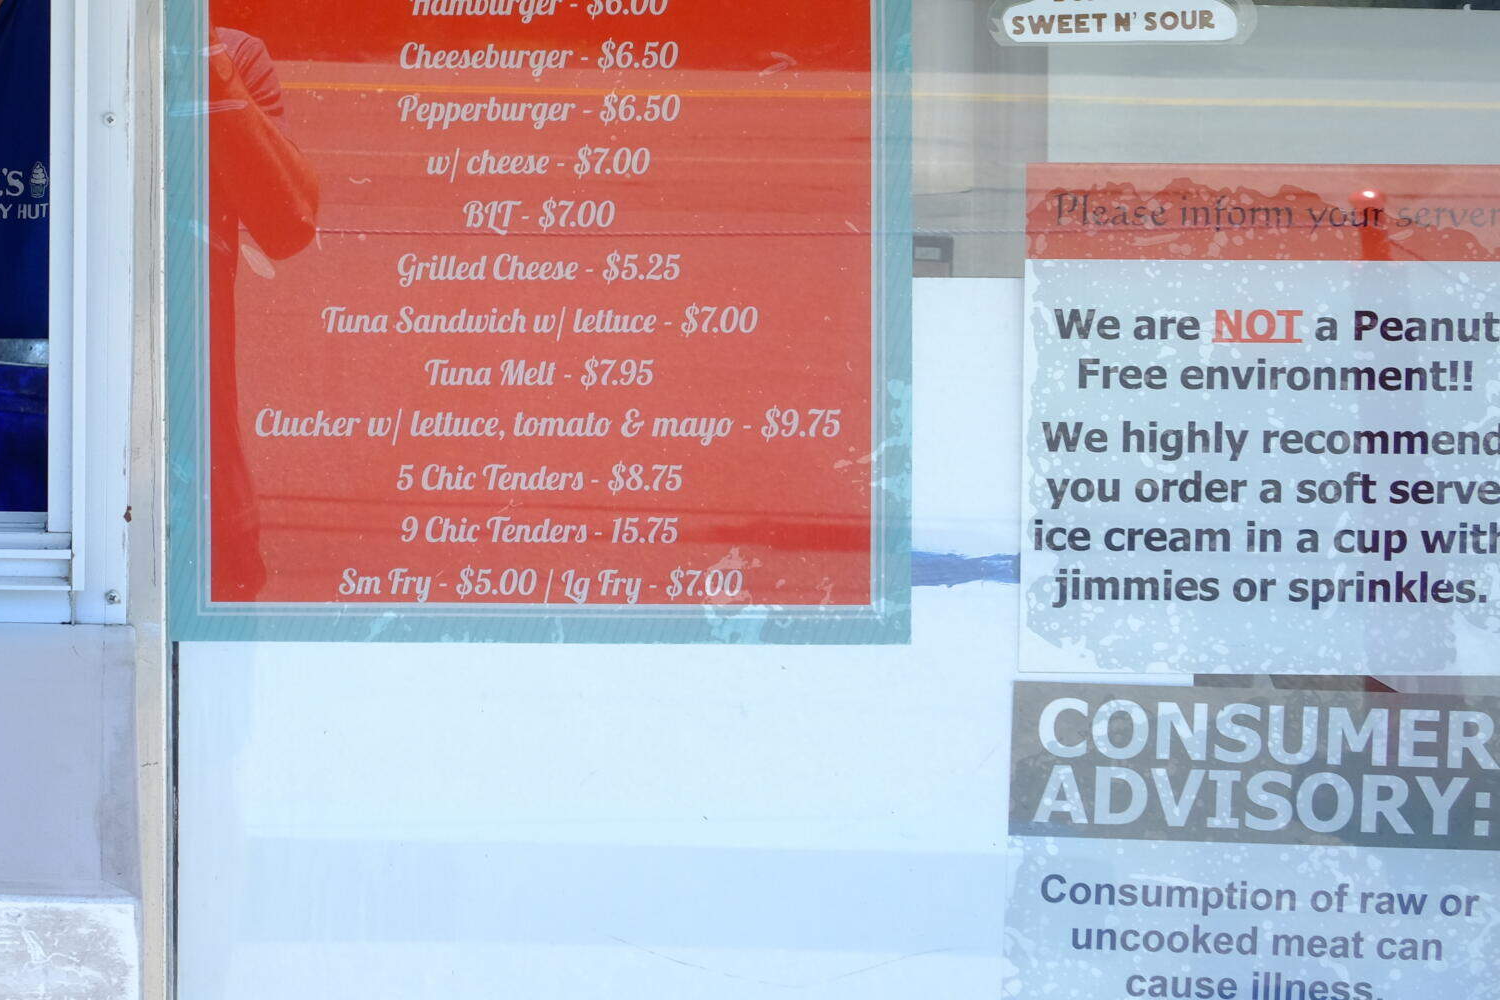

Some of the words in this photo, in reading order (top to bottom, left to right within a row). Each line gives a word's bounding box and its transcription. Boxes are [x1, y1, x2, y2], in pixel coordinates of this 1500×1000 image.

[1011, 13, 1107, 36] SWEET
[1115, 12, 1139, 33] N'
[1145, 8, 1216, 31] SOUR
[399, 42, 573, 75] Cheeseburger
[598, 40, 679, 71] $6.50
[427, 148, 460, 183] w/
[468, 153, 549, 176] cheese
[574, 146, 651, 178] $7.00
[17, 203, 48, 219] HUT
[1054, 190, 1167, 231] Please
[1179, 192, 1295, 234] inform
[1305, 204, 1383, 234] your
[397, 253, 485, 287] Grilled
[491, 253, 579, 283] Cheese
[603, 252, 681, 283] $5.25
[1054, 308, 1121, 340] We
[1133, 315, 1200, 340] are
[1212, 309, 1304, 343] NOT
[1314, 318, 1339, 340] a
[1354, 309, 1500, 342] Peanut
[1077, 360, 1167, 390] Free
[1180, 360, 1475, 393] environment!!
[255, 410, 361, 440] Clucker
[368, 409, 402, 446] w/
[410, 410, 504, 440] lettuce,
[513, 414, 612, 439] tomato
[621, 410, 644, 438] &
[653, 416, 734, 448] mayo
[761, 409, 841, 441] $9.75
[1041, 421, 1109, 452] We
[1121, 422, 1249, 461] highly
[1051, 570, 1220, 608] jimmies
[1232, 577, 1277, 602] or
[1288, 572, 1488, 608] sprinkles.
[1037, 698, 1500, 770] CONSUMER
[1034, 766, 1492, 836] ADVISORY:
[1039, 875, 1299, 918] Consumption
[1309, 884, 1350, 915] of
[1360, 887, 1429, 916] raw
[1438, 891, 1479, 918] or
[1069, 924, 1258, 958] uncooked
[1271, 930, 1364, 960] meat
[1377, 934, 1444, 961] can
